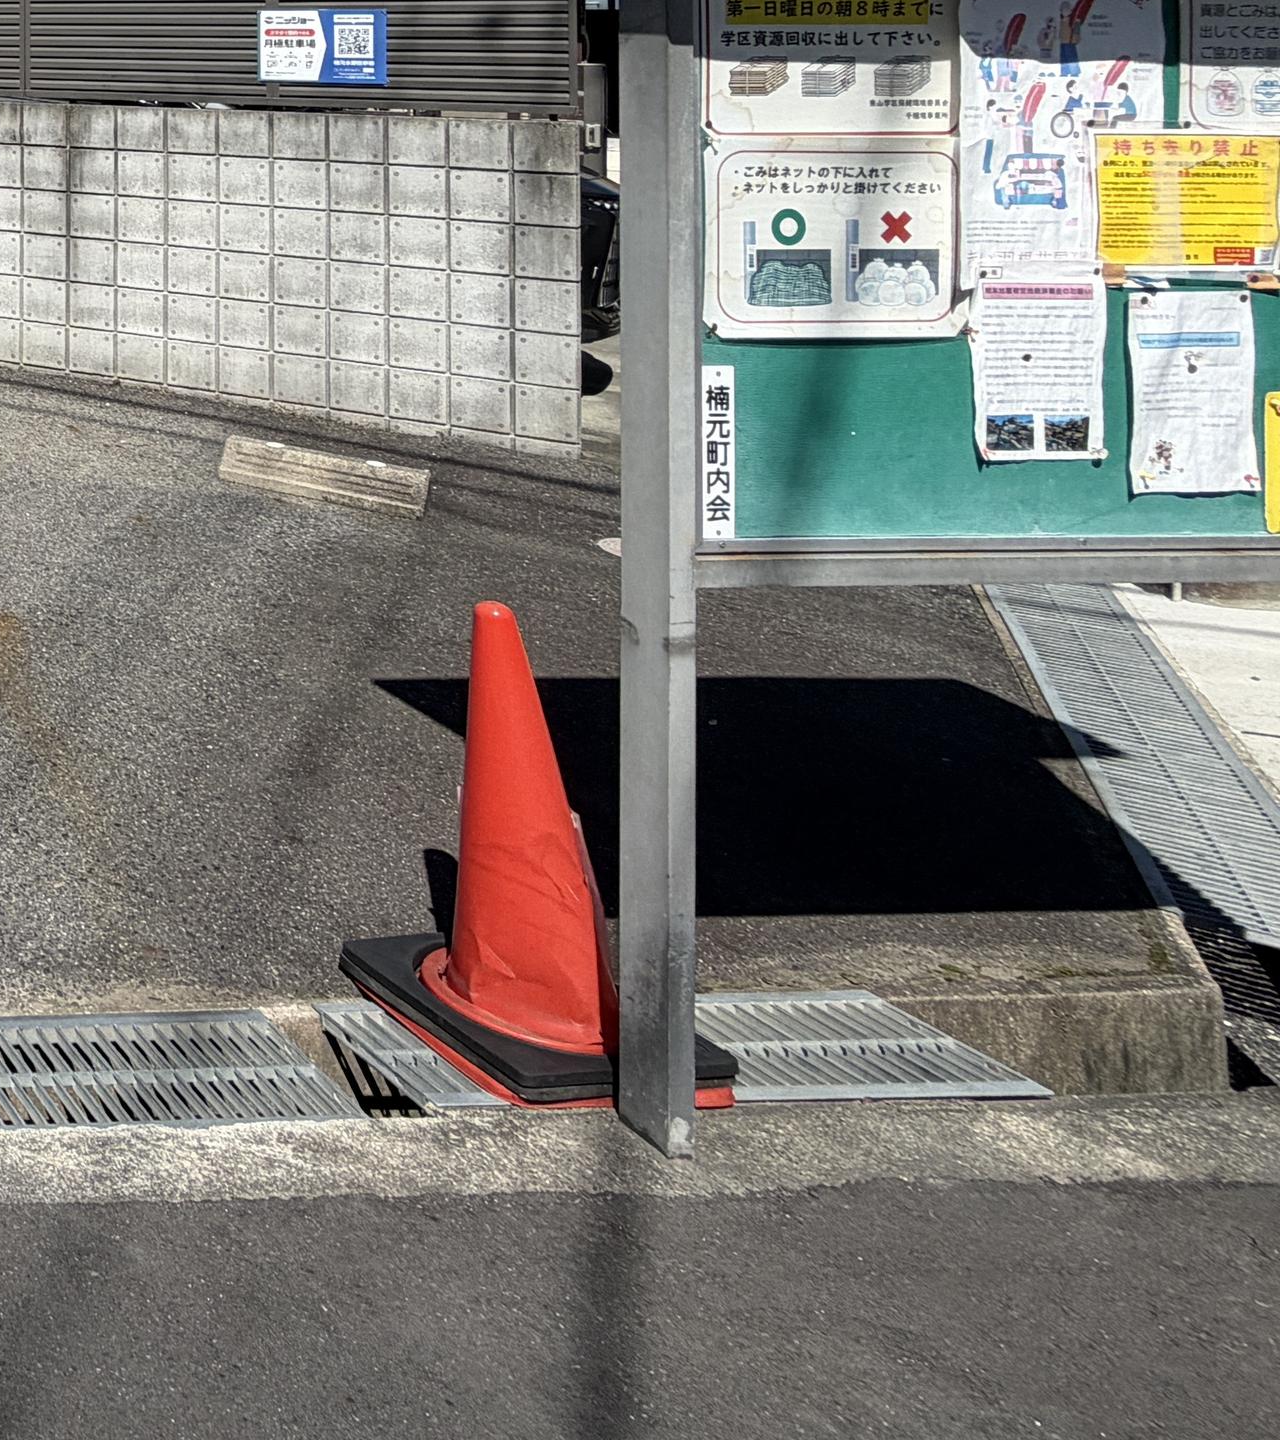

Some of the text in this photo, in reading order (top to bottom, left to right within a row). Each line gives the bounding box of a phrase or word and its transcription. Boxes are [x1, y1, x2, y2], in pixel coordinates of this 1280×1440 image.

[725, 0, 944, 18] 第一日曜日の朝8時までに
[264, 39, 316, 48] 月極駐車場
[720, 30, 942, 48] 学区資源回収に出して下さい。
[705, 384, 731, 522] 楠元町内会
